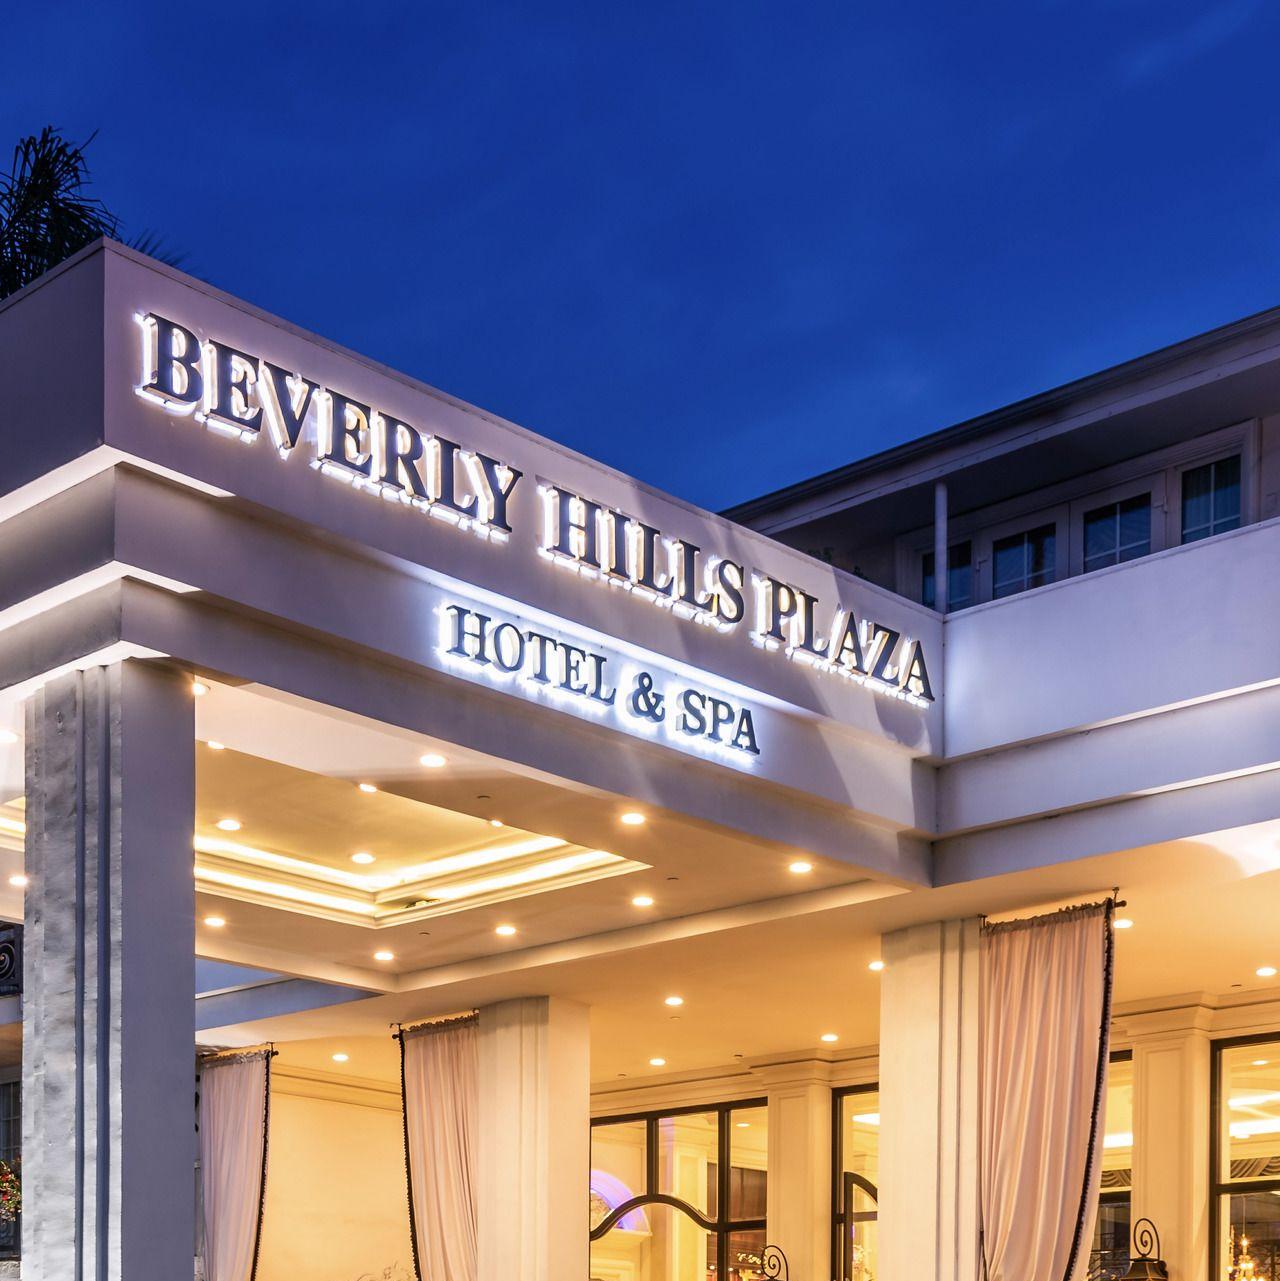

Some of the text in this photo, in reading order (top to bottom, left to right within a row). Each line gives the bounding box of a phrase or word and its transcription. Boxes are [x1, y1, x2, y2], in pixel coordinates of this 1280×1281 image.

[136, 311, 936, 708] BEVERLY HILLS PLAZA
[441, 603, 761, 757] HOTEL & SPA
